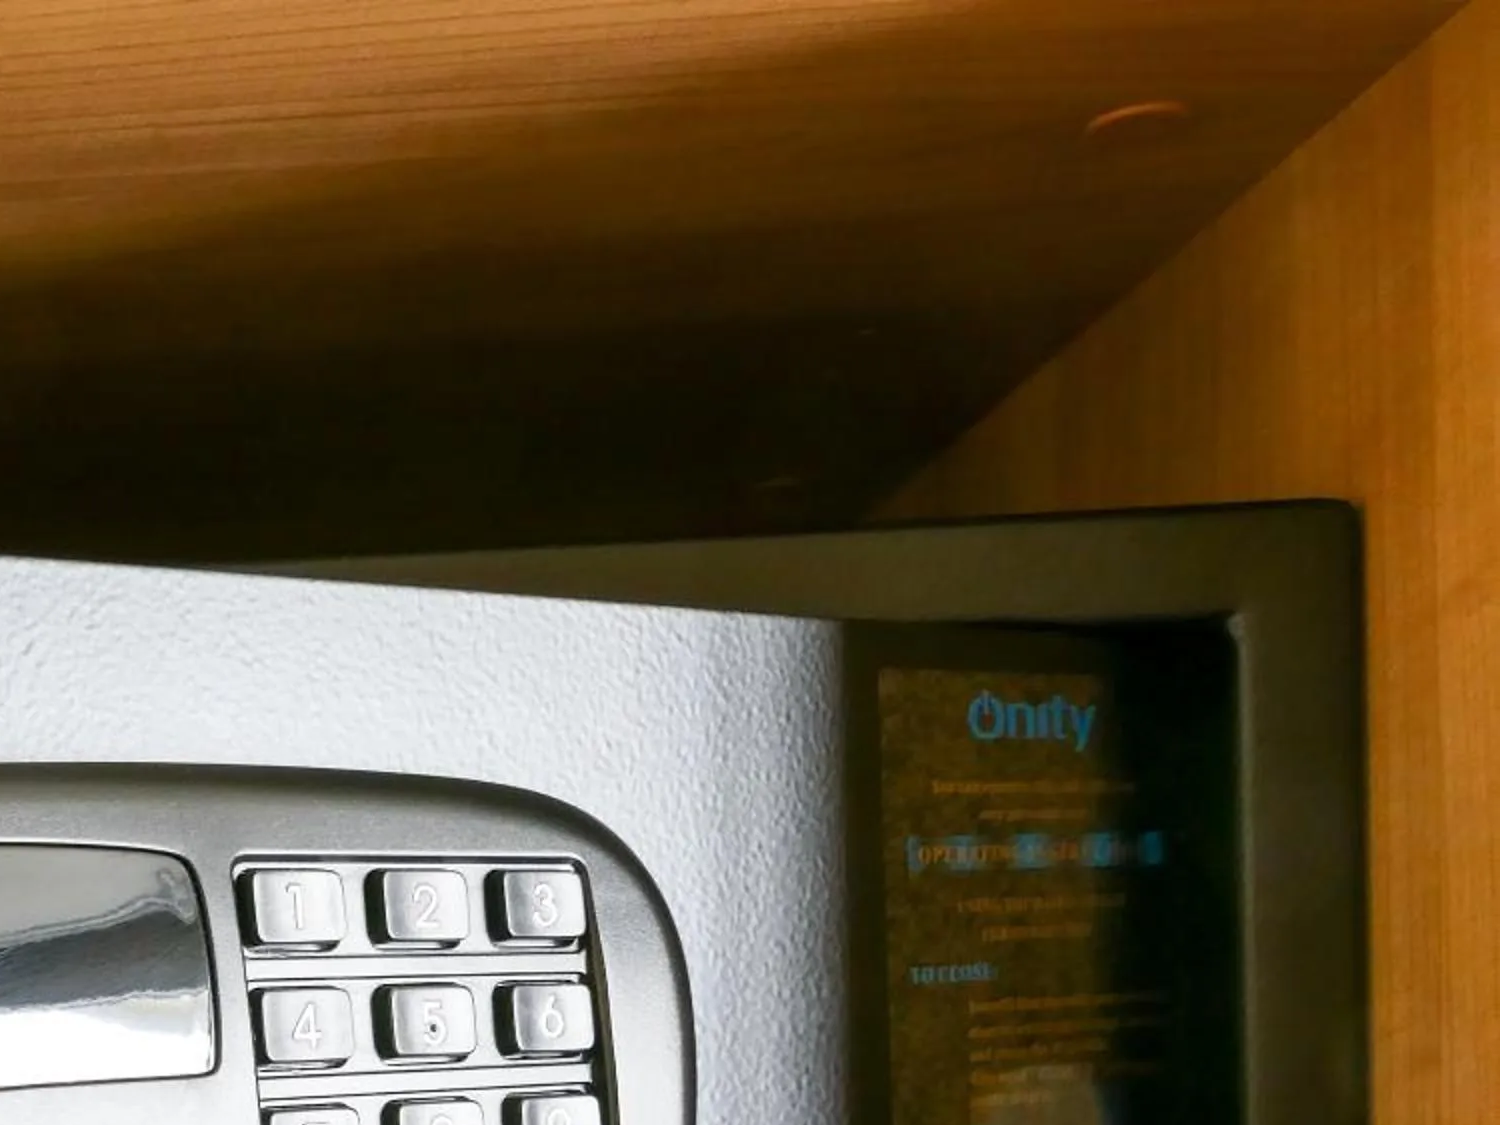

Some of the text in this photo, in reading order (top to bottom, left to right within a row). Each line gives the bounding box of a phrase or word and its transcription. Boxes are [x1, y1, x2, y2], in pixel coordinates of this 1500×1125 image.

[967, 689, 1096, 752] Onity
[285, 882, 560, 930] 1 2 3
[292, 994, 565, 1049] 4 5 6
